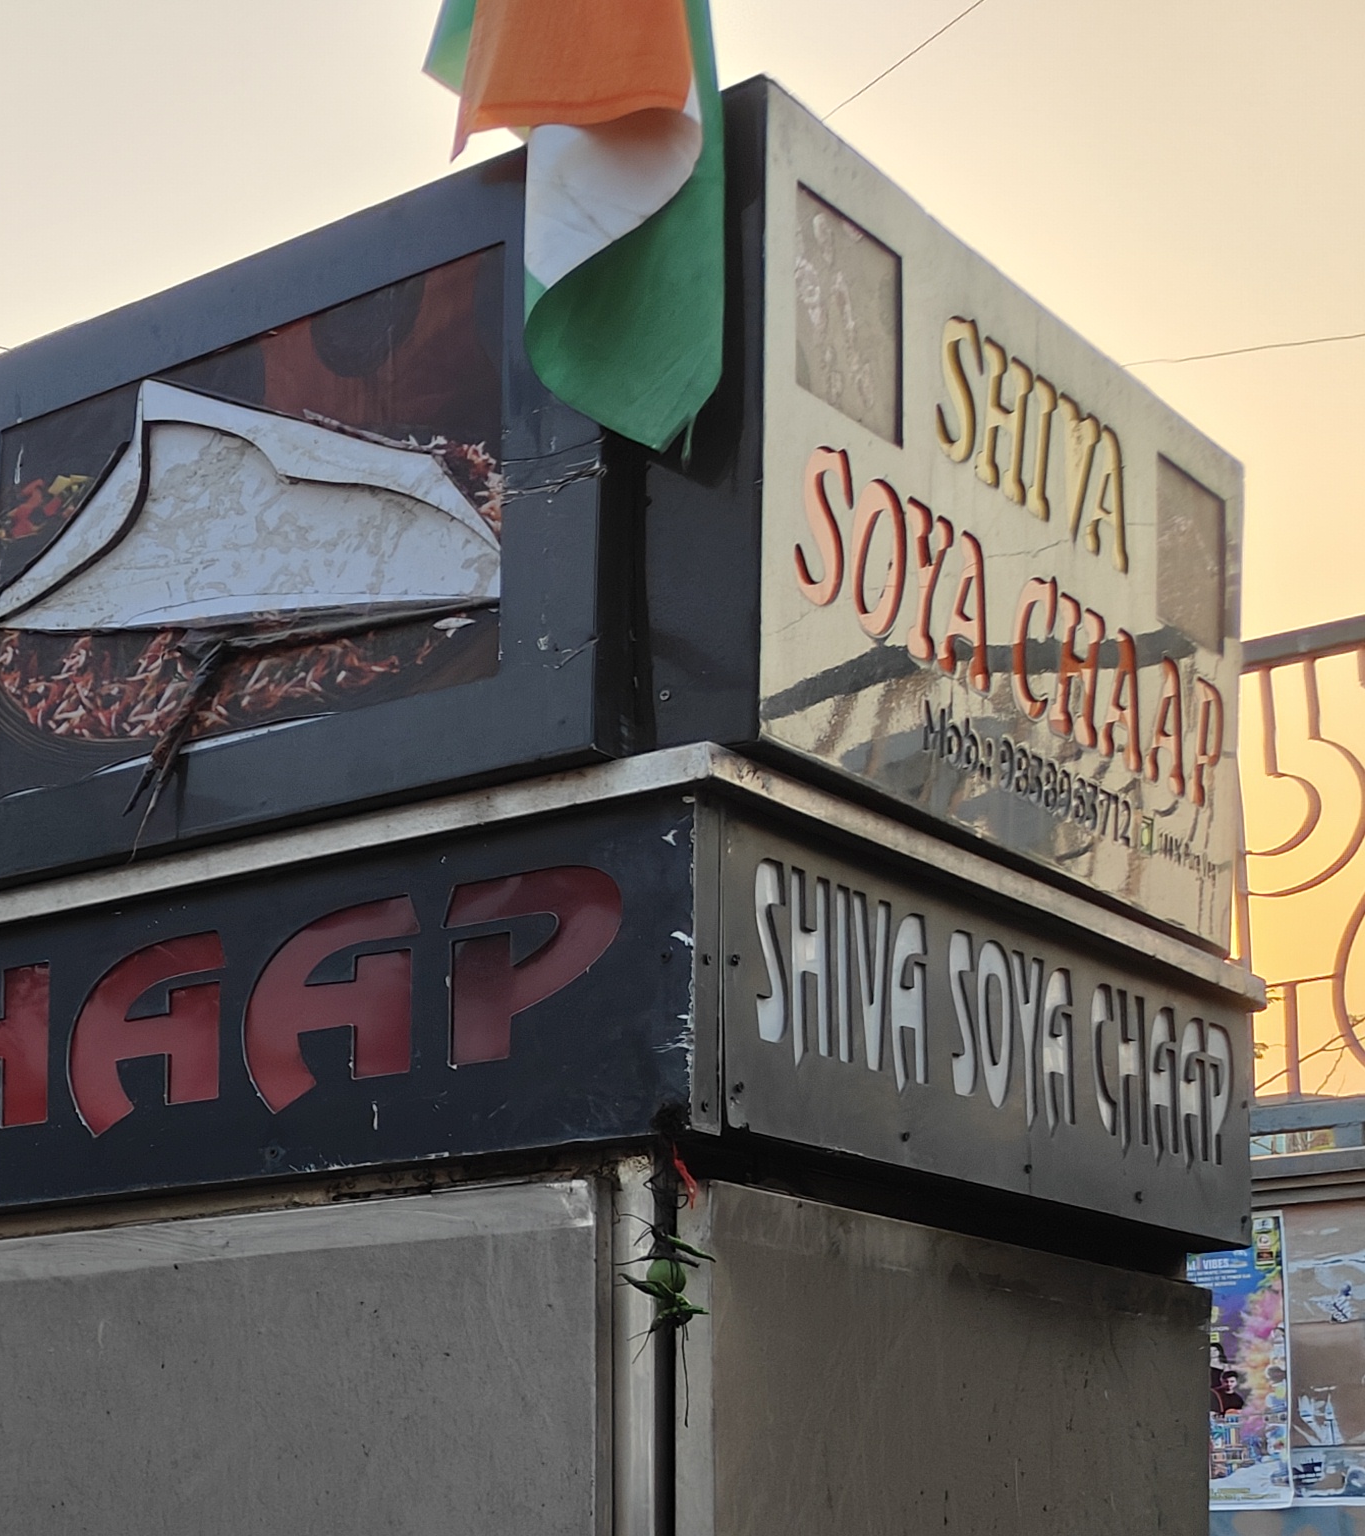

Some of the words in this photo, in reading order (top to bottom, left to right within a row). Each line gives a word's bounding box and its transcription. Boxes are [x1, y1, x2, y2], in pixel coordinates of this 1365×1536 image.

[936, 315, 1128, 575] SHIVA
[794, 445, 991, 695] SOYA
[1011, 577, 1224, 808] CHAAP
[1000, 733, 1131, 848] 9838963712
[754, 857, 929, 1095] SHIVA
[949, 929, 1076, 1137] SOYA
[1091, 982, 1234, 1170] CHAAP
